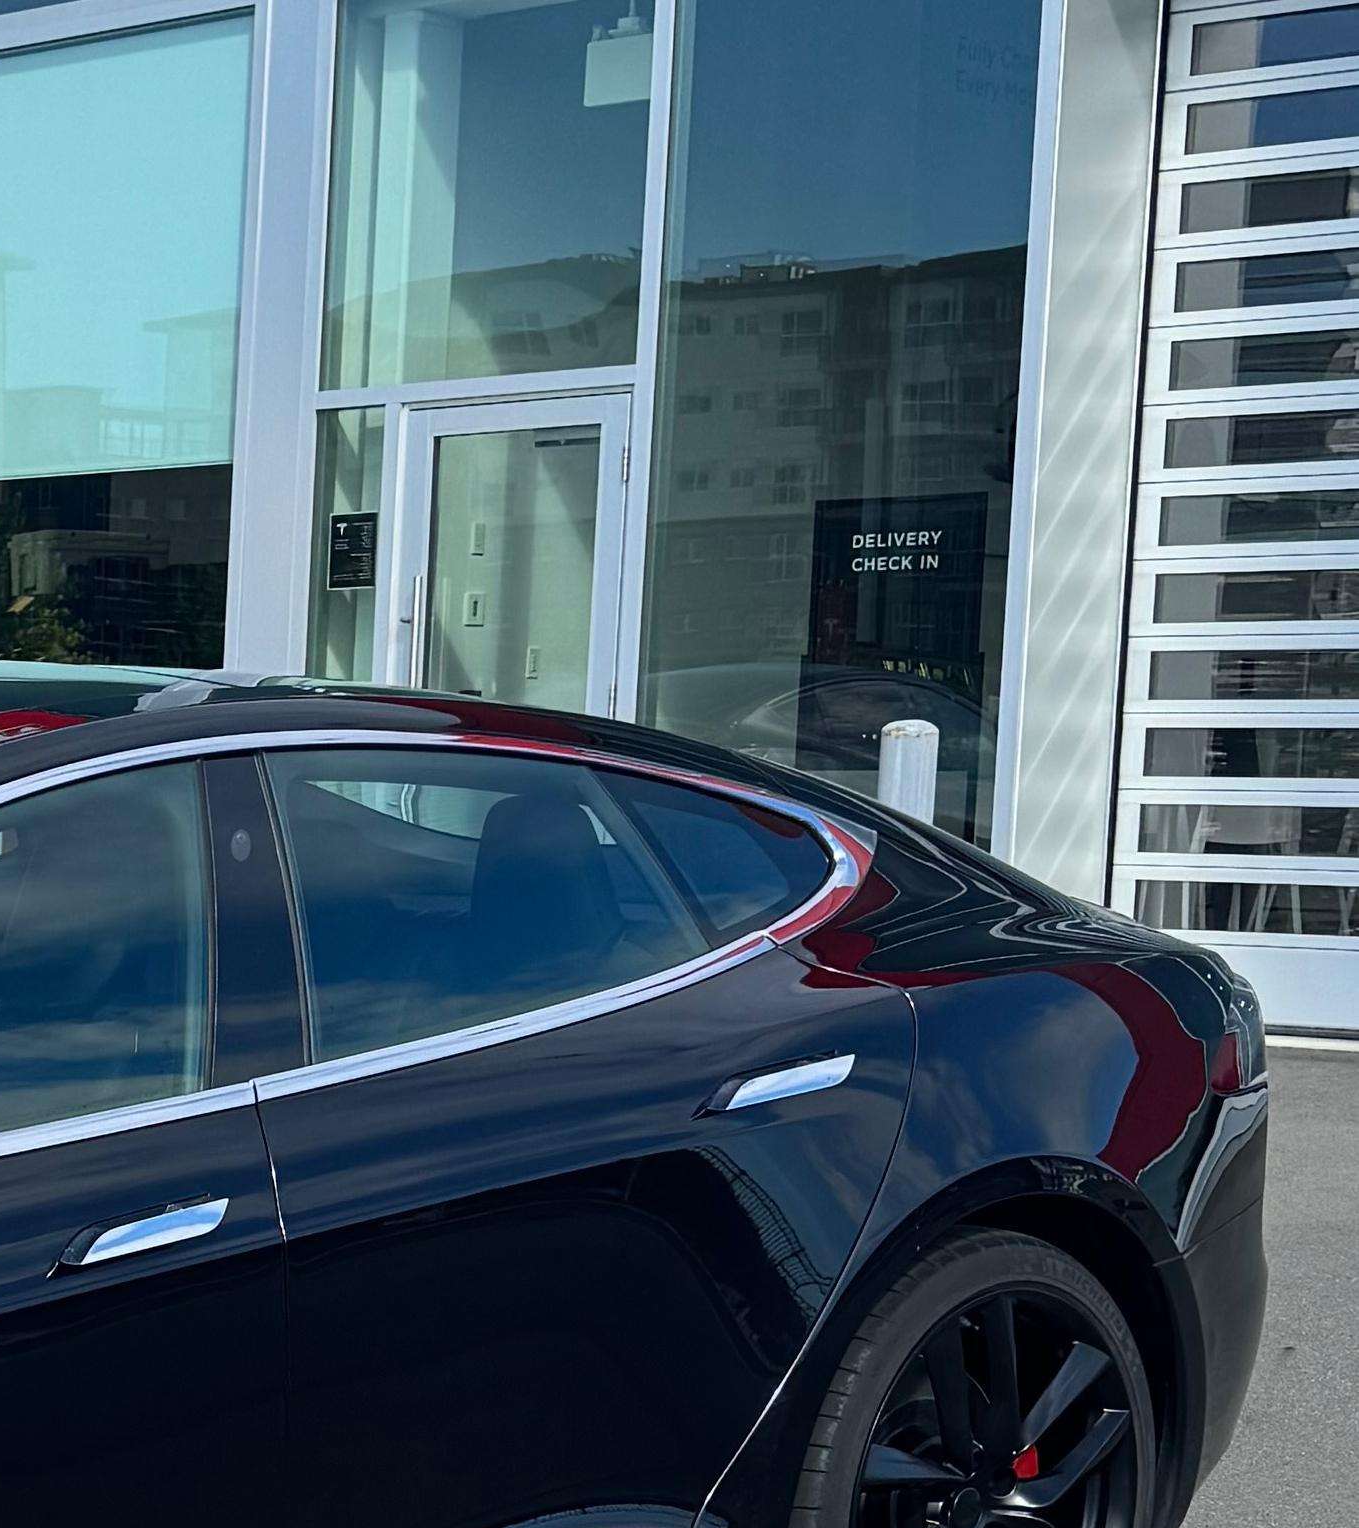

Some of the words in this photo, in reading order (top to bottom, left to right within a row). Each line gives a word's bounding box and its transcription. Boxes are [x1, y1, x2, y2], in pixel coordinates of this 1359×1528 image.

[852, 530, 942, 548] DELIVERY
[851, 555, 913, 572] CHECK
[920, 554, 939, 570] IN
